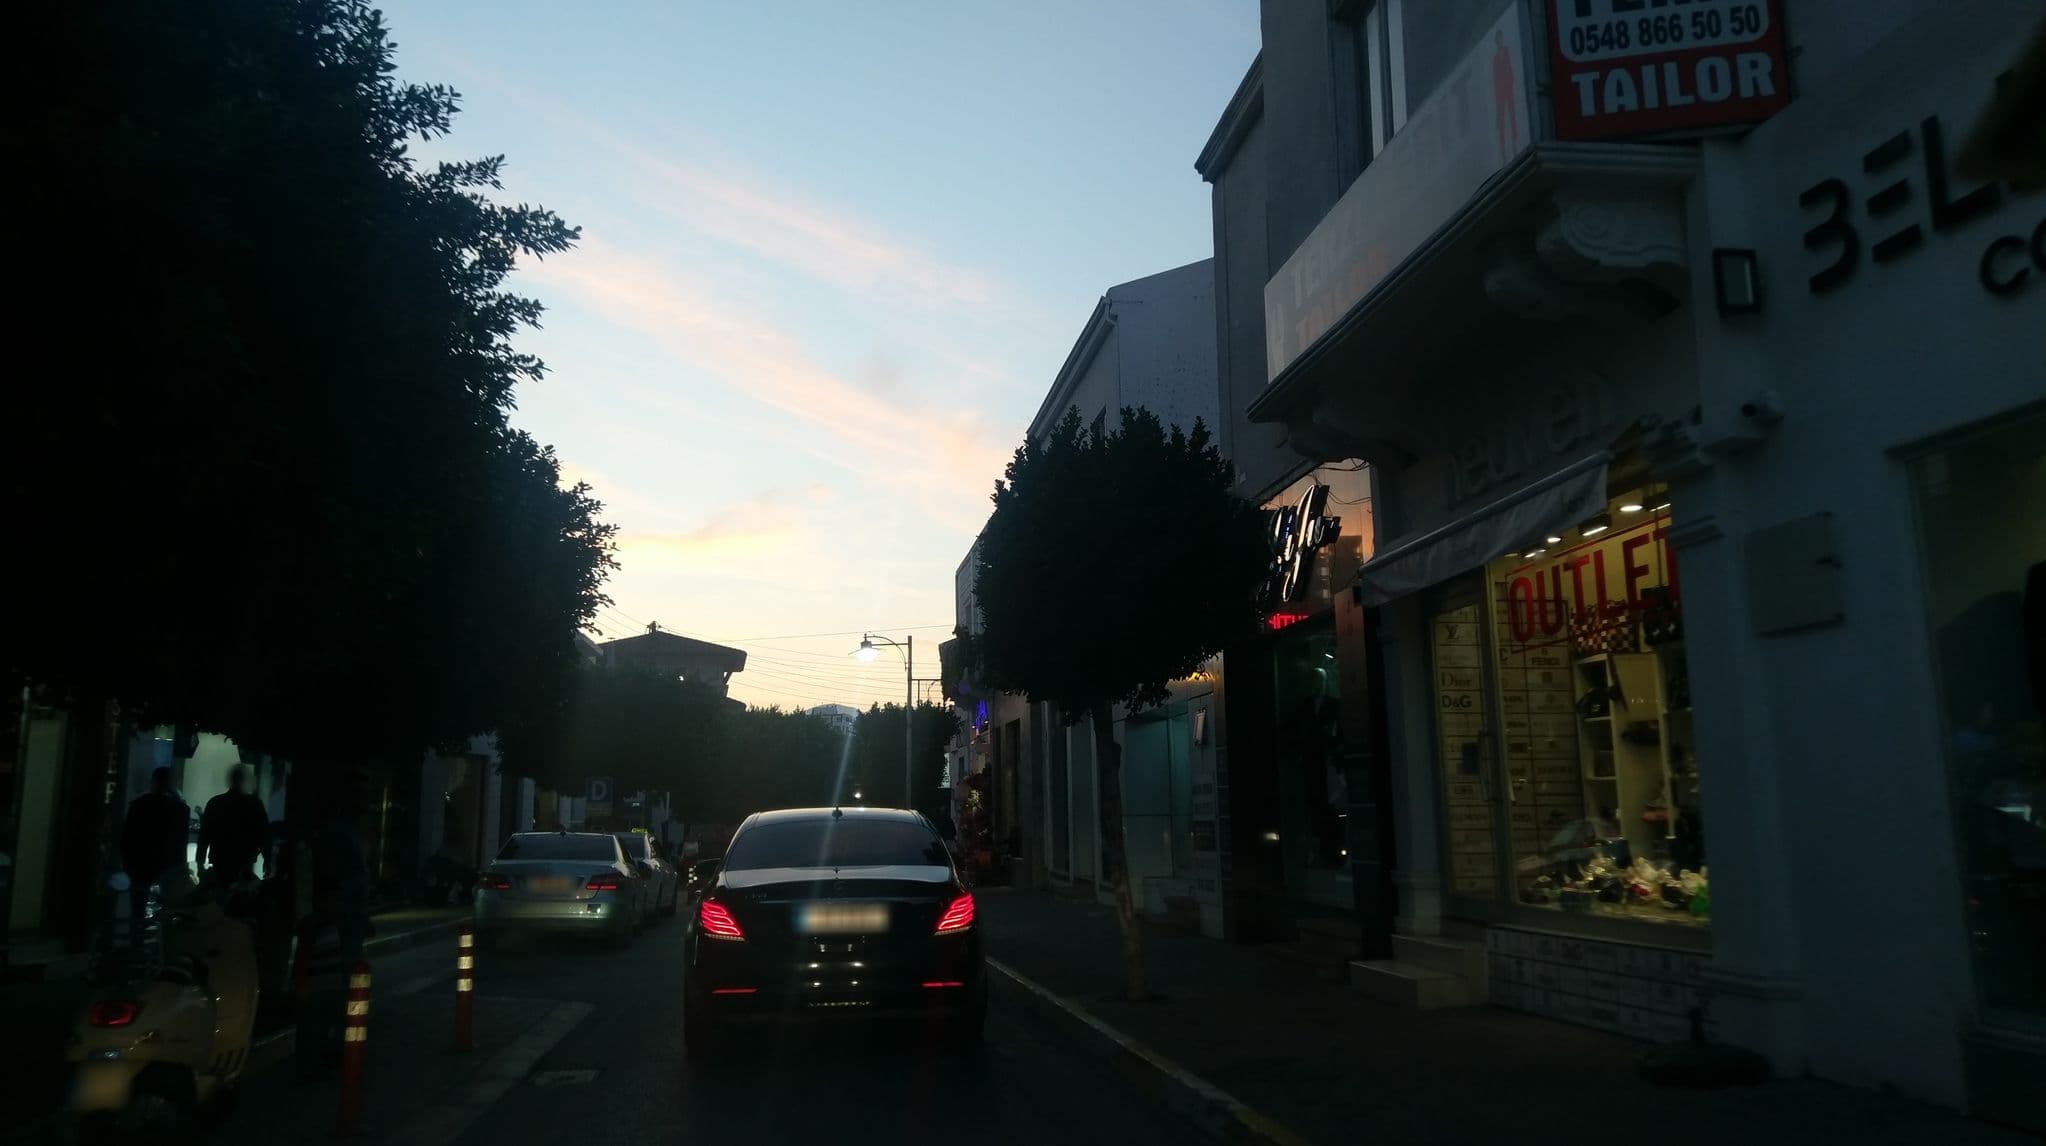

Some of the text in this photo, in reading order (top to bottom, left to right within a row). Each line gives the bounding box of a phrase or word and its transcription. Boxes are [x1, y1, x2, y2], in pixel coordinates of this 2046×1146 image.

[1570, 20, 1631, 55] 0548
[1637, 13, 1684, 47] 866
[1691, 9, 1722, 40] 50
[1728, 4, 1761, 36] 50
[1570, 51, 1776, 118] TAILOR
[1441, 671, 1472, 687] Dior
[1441, 694, 1472, 709] D&G
